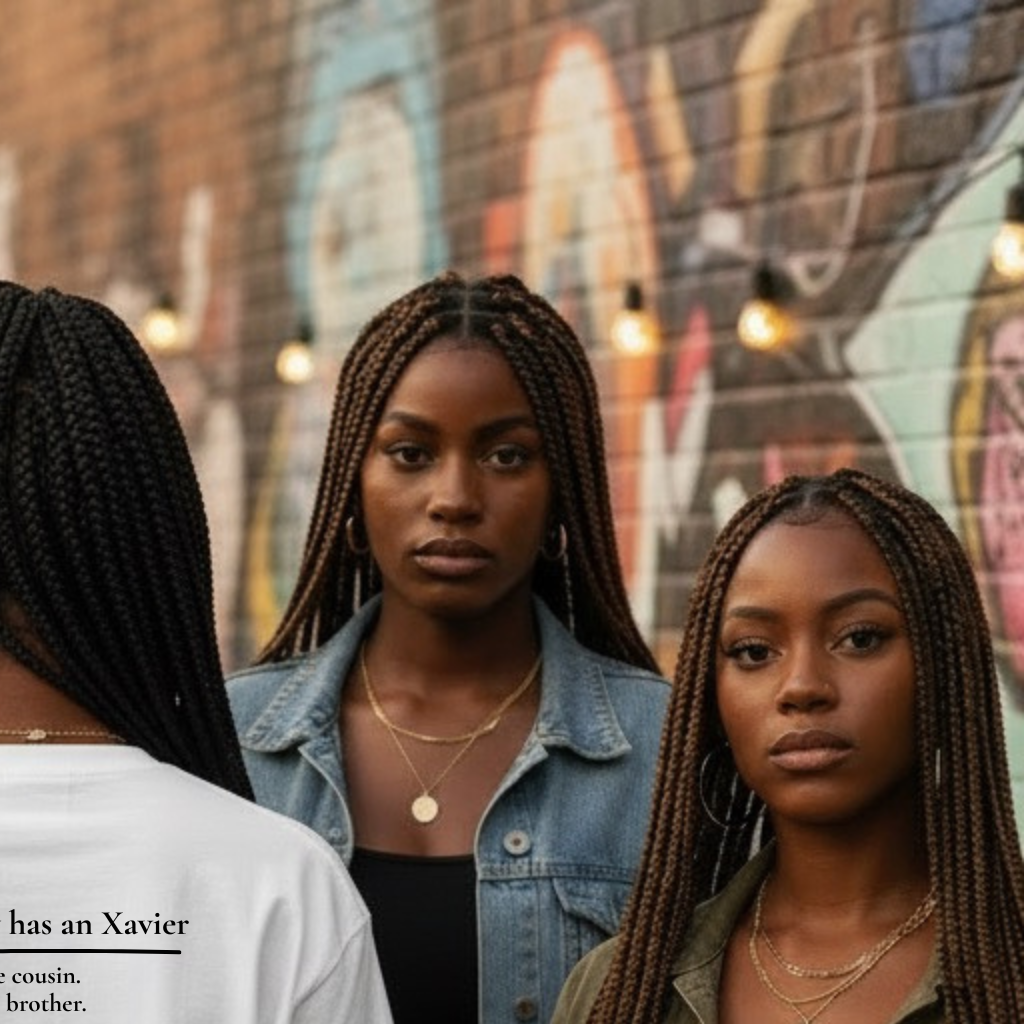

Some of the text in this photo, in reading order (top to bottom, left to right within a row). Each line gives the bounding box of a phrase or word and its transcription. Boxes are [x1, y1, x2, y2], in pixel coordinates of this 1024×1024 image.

[8, 908, 52, 935] has
[61, 919, 93, 935] an
[101, 911, 190, 936] Xavier
[11, 966, 81, 984] cousin.
[5, 992, 87, 1012] brother.
